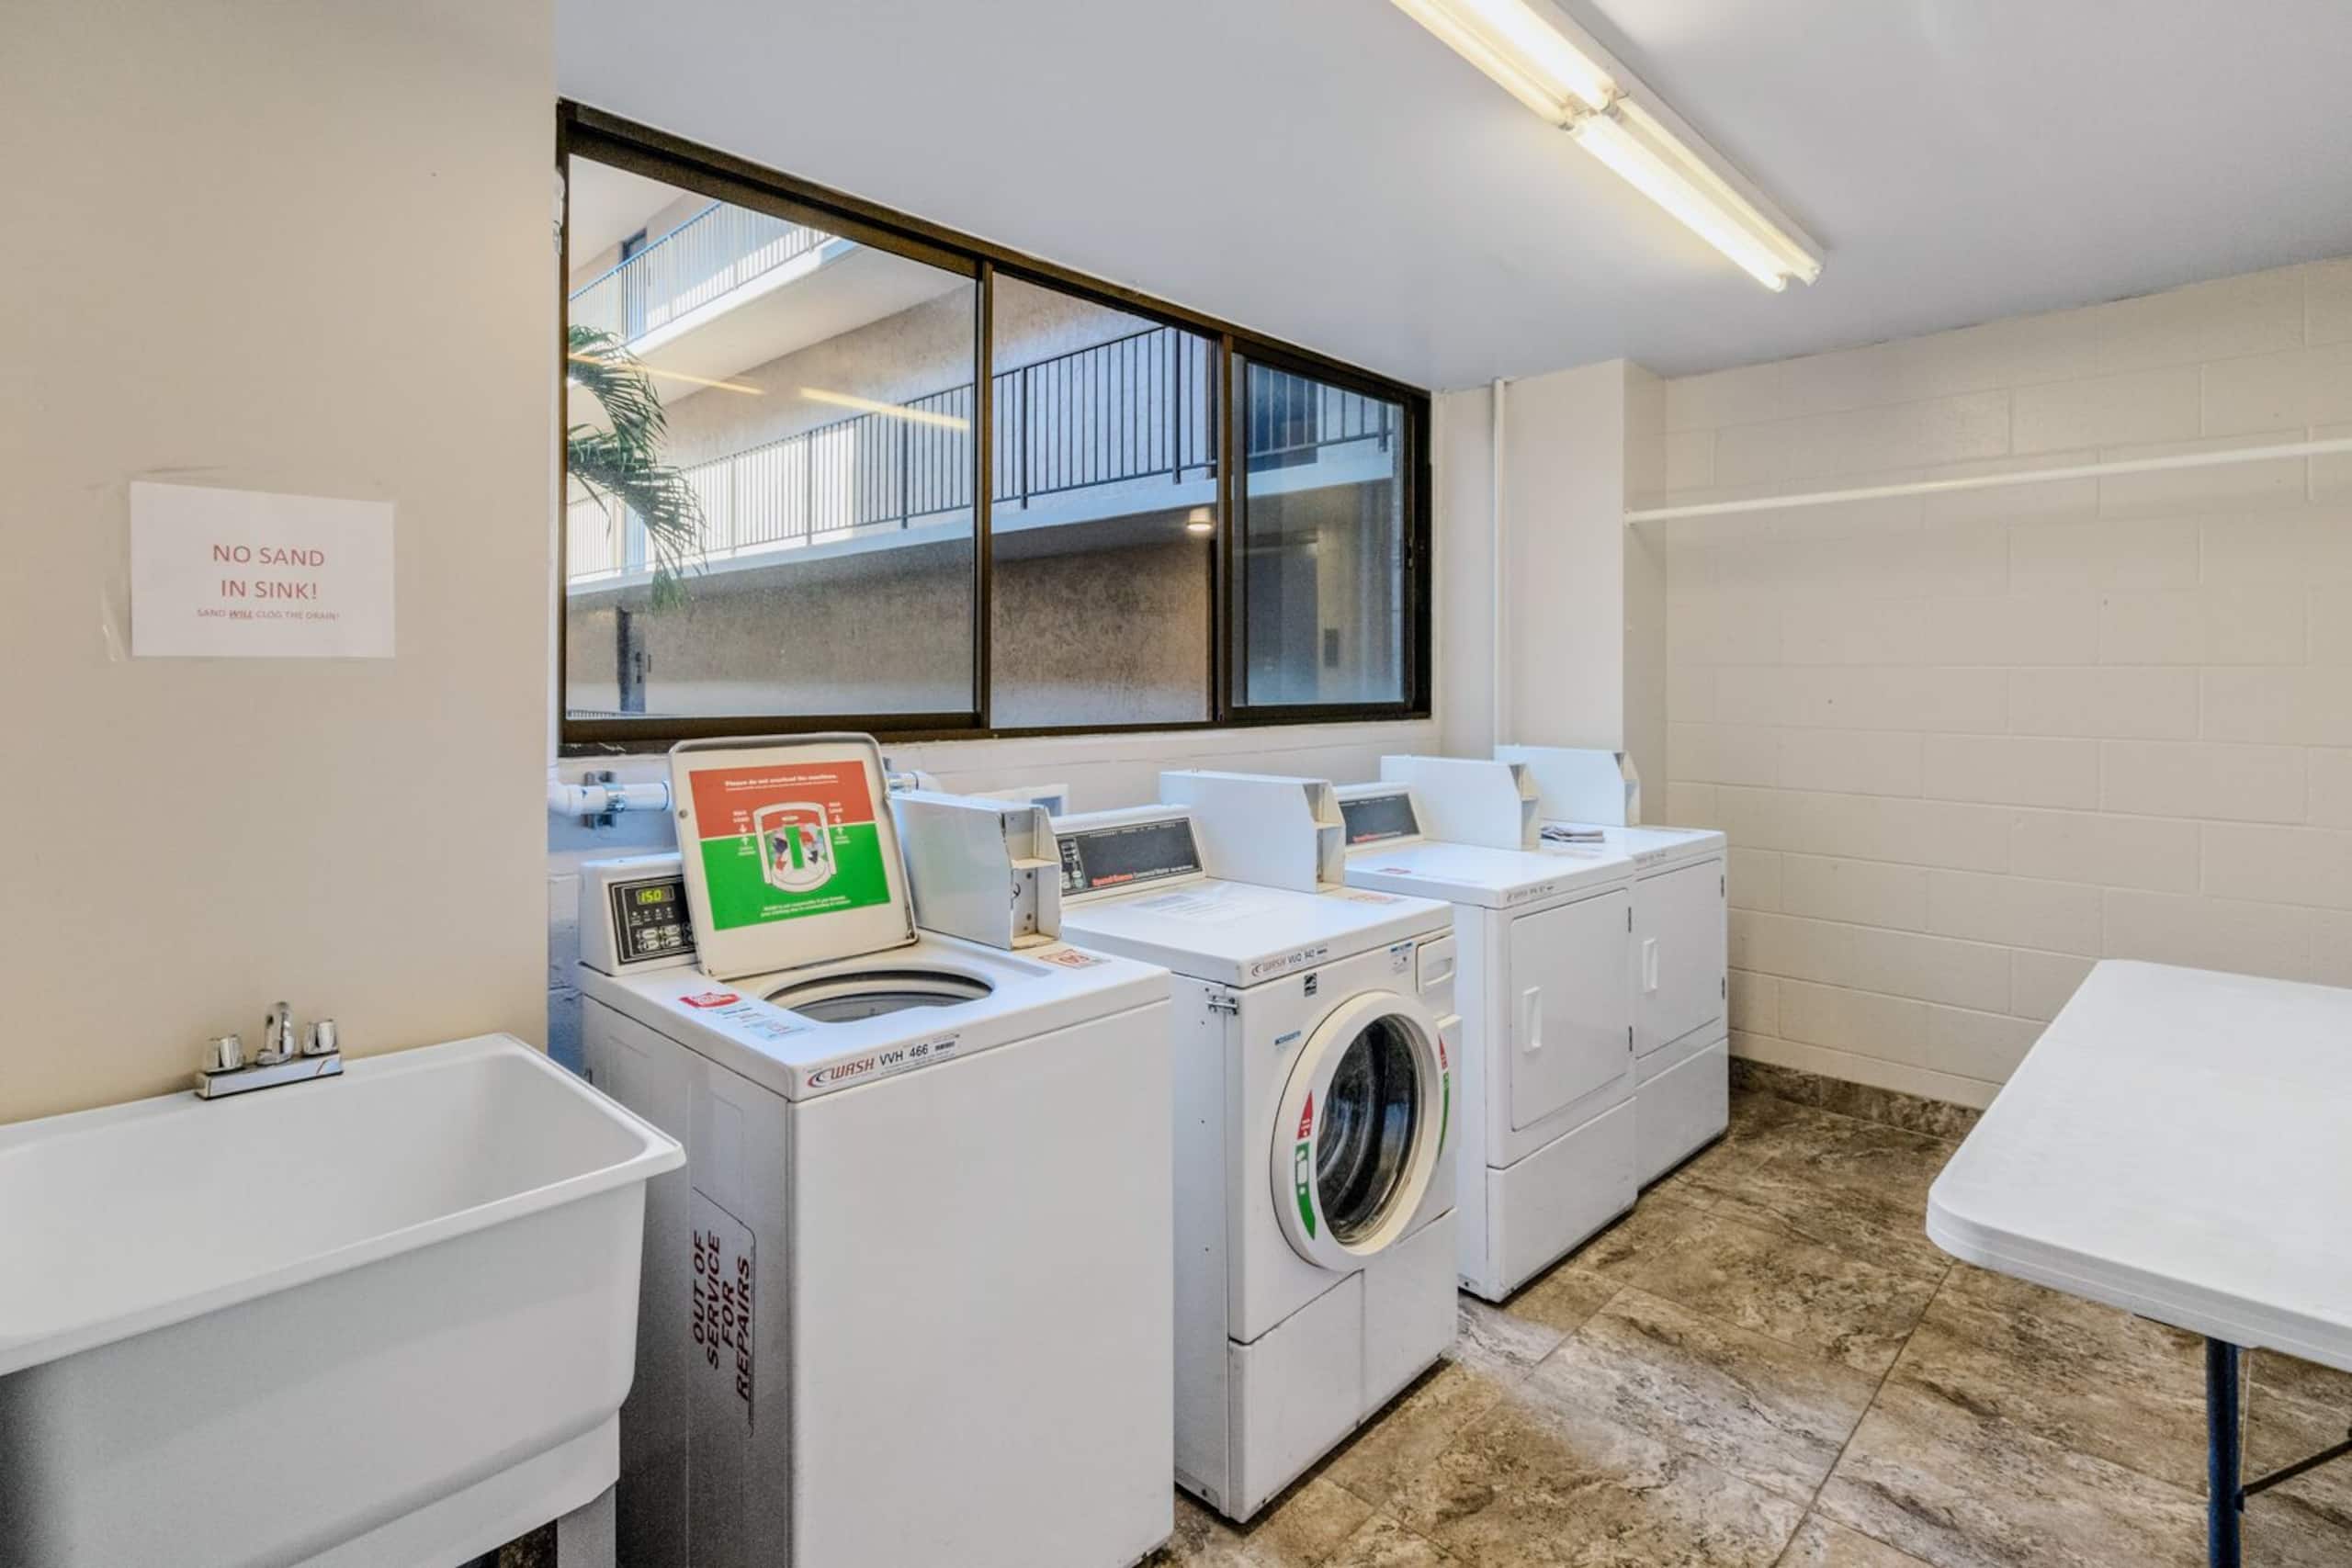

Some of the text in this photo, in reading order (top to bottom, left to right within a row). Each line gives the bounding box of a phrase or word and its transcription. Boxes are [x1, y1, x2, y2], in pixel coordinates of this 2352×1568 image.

[212, 544, 325, 568] NO SAND
[197, 608, 226, 618] SAND
[255, 610, 283, 619] CLOG
[285, 611, 304, 619] THE
[220, 579, 318, 600] IN SINK!
[830, 1056, 875, 1080] WASH
[878, 1050, 904, 1066] VVH
[910, 1043, 929, 1058] 466
[693, 1229, 706, 1345] OUT OF
[707, 1229, 720, 1371] SERVICE
[721, 1280, 735, 1348] FOR
[737, 1256, 751, 1402] REPAIRS
